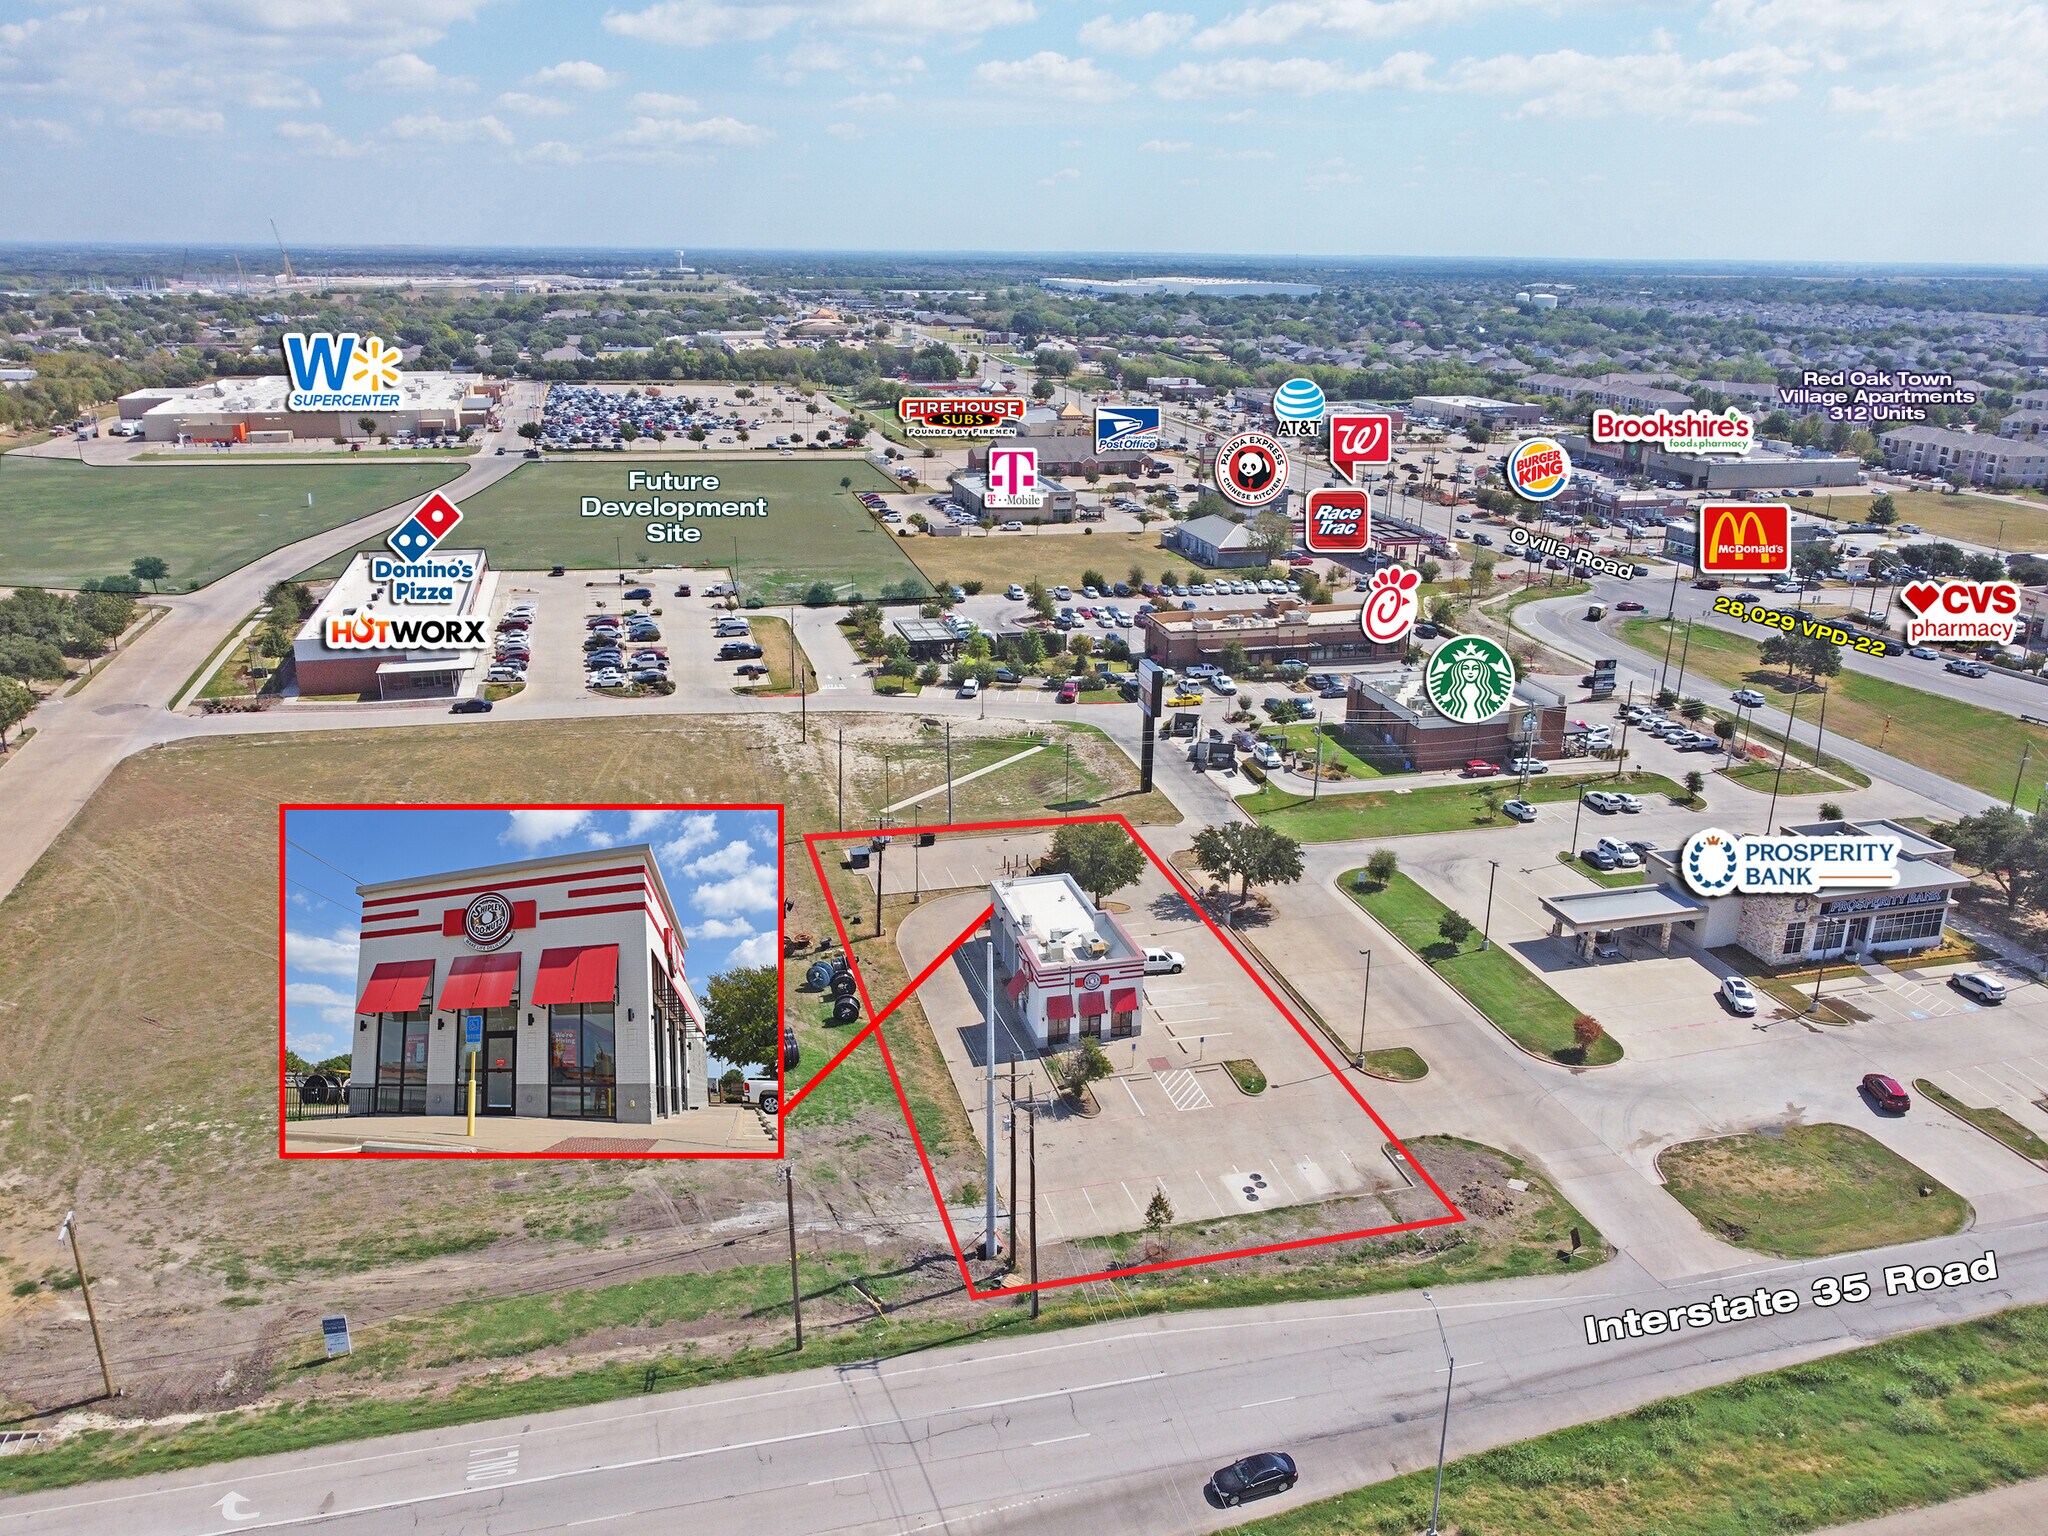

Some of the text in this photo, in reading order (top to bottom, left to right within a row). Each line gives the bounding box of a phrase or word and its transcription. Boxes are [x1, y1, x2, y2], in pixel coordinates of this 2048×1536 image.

[473, 903, 503, 918] SHIPLEY
[1830, 890, 1942, 912] PROSPERITY BANK
[466, 1444, 521, 1481] ONLY
